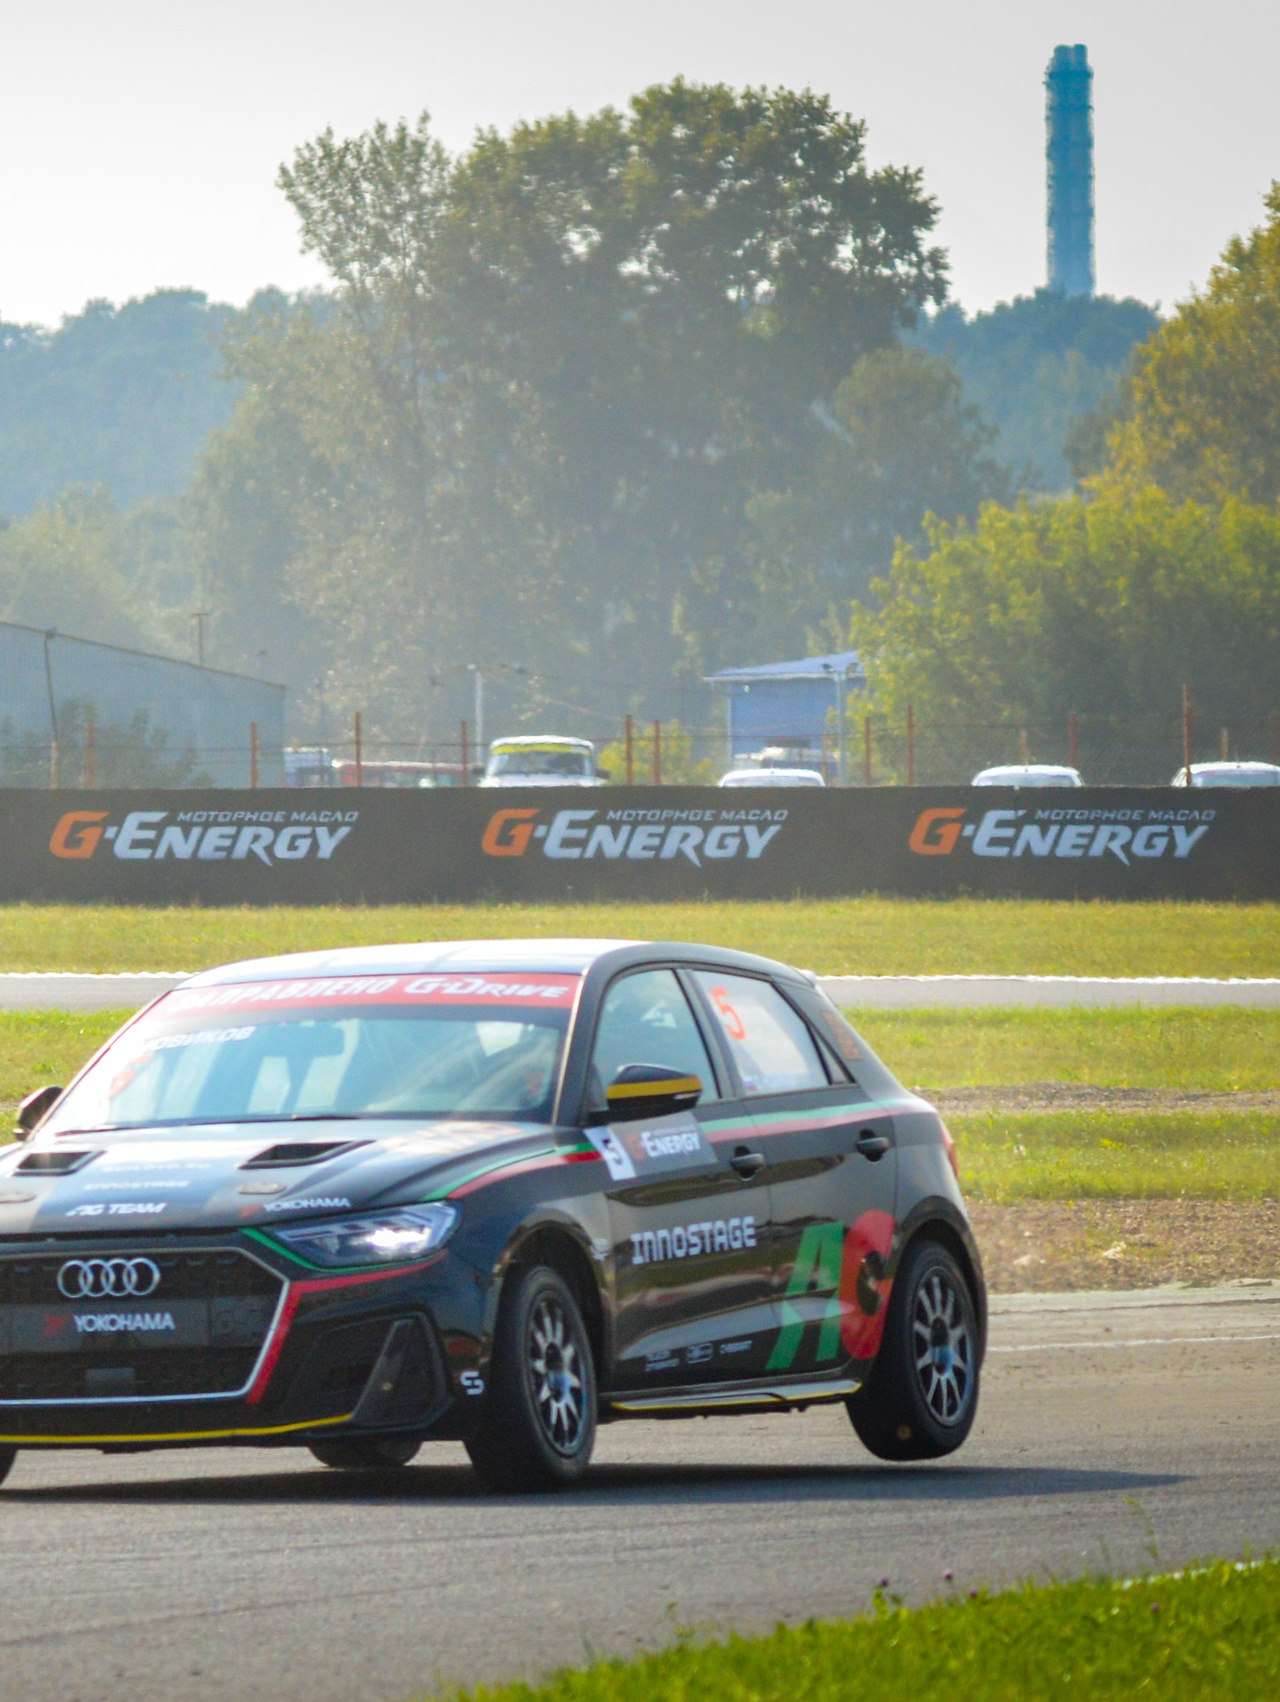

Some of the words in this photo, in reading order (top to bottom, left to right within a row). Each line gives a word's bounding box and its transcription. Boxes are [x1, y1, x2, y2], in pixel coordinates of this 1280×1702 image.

[176, 810, 286, 822] МОТОРНОЕ
[290, 810, 359, 822] МАСЛО
[606, 808, 716, 821] МОТОРНОЕ
[720, 808, 789, 821] МАСЛО
[1033, 808, 1143, 821] МОТОРНОЕ
[1148, 808, 1216, 821] МАСЛО
[709, 986, 747, 1041] 5
[107, 1202, 167, 1215] TEAM
[264, 1197, 352, 1213] YOKOHAMA
[630, 1215, 757, 1265] INNOSTAGE
[73, 1312, 175, 1333] YOKOHAMA
